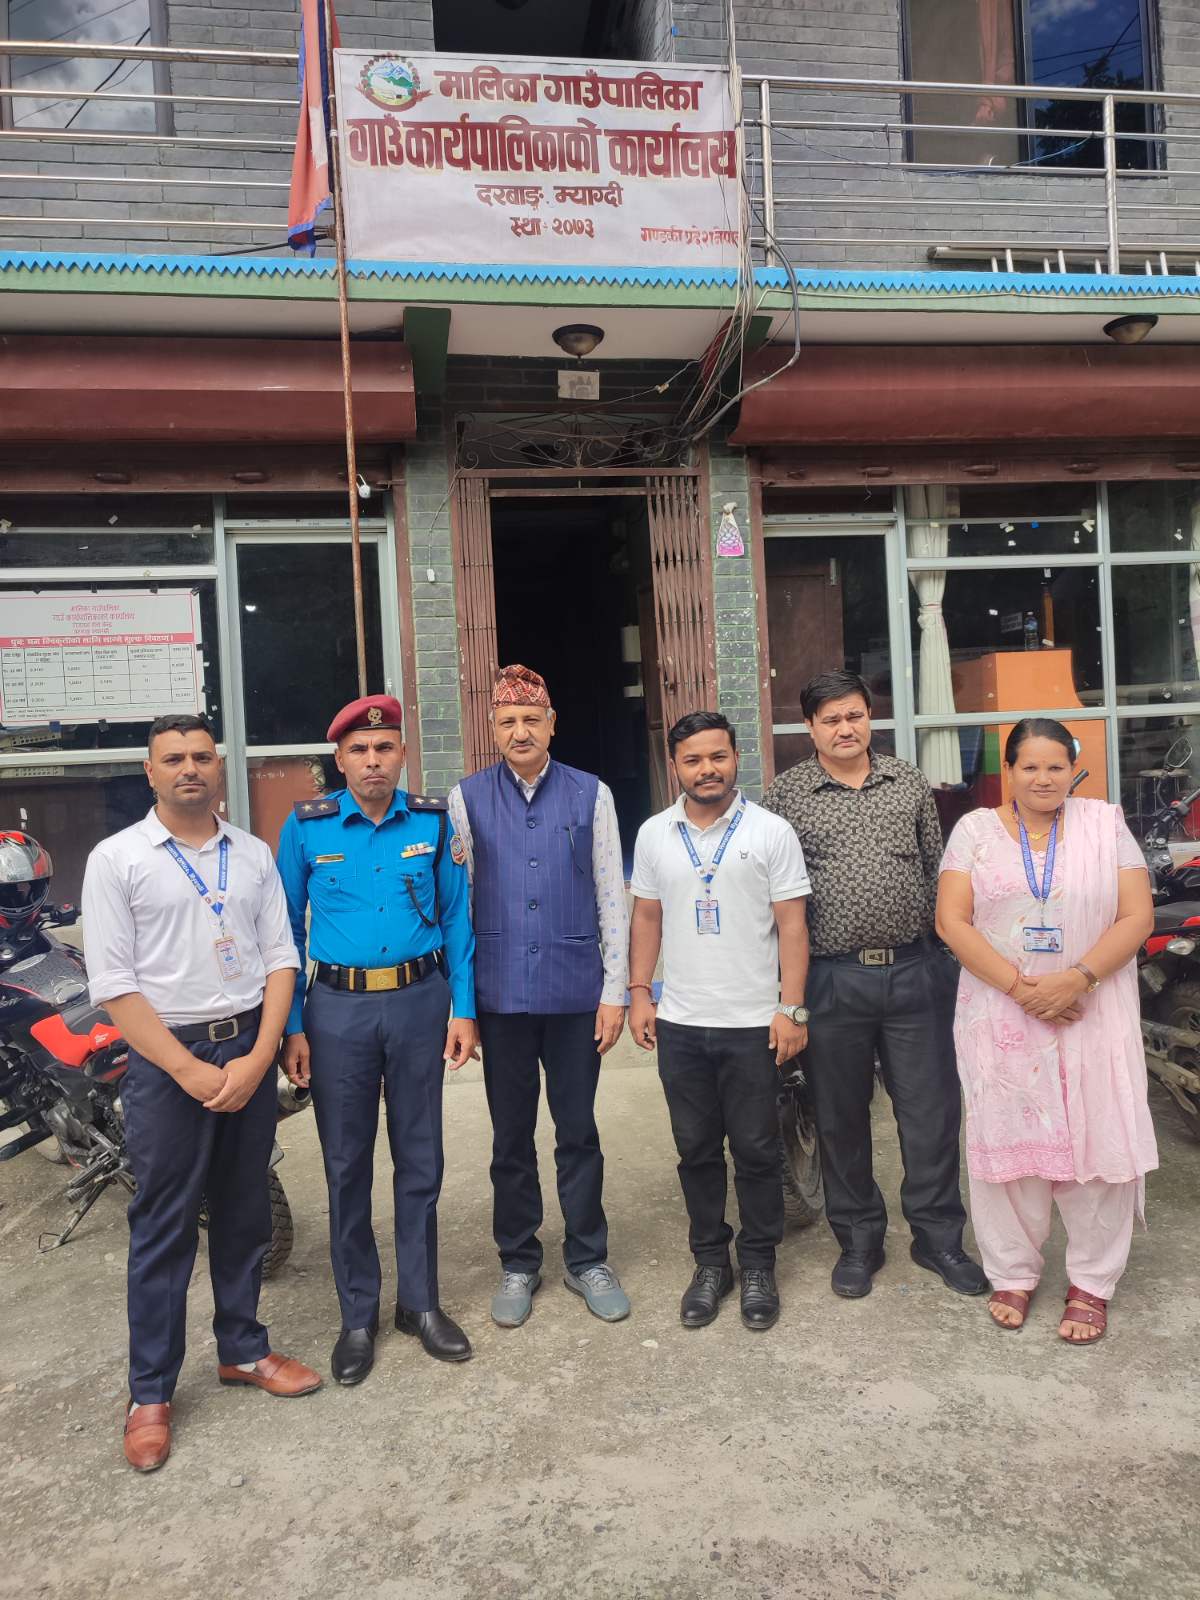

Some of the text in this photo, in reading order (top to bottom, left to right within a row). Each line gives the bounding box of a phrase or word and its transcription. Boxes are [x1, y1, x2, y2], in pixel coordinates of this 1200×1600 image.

[434, 65, 703, 111] मालिका गाउँपालिका
[604, 122, 737, 178] कार्यालय
